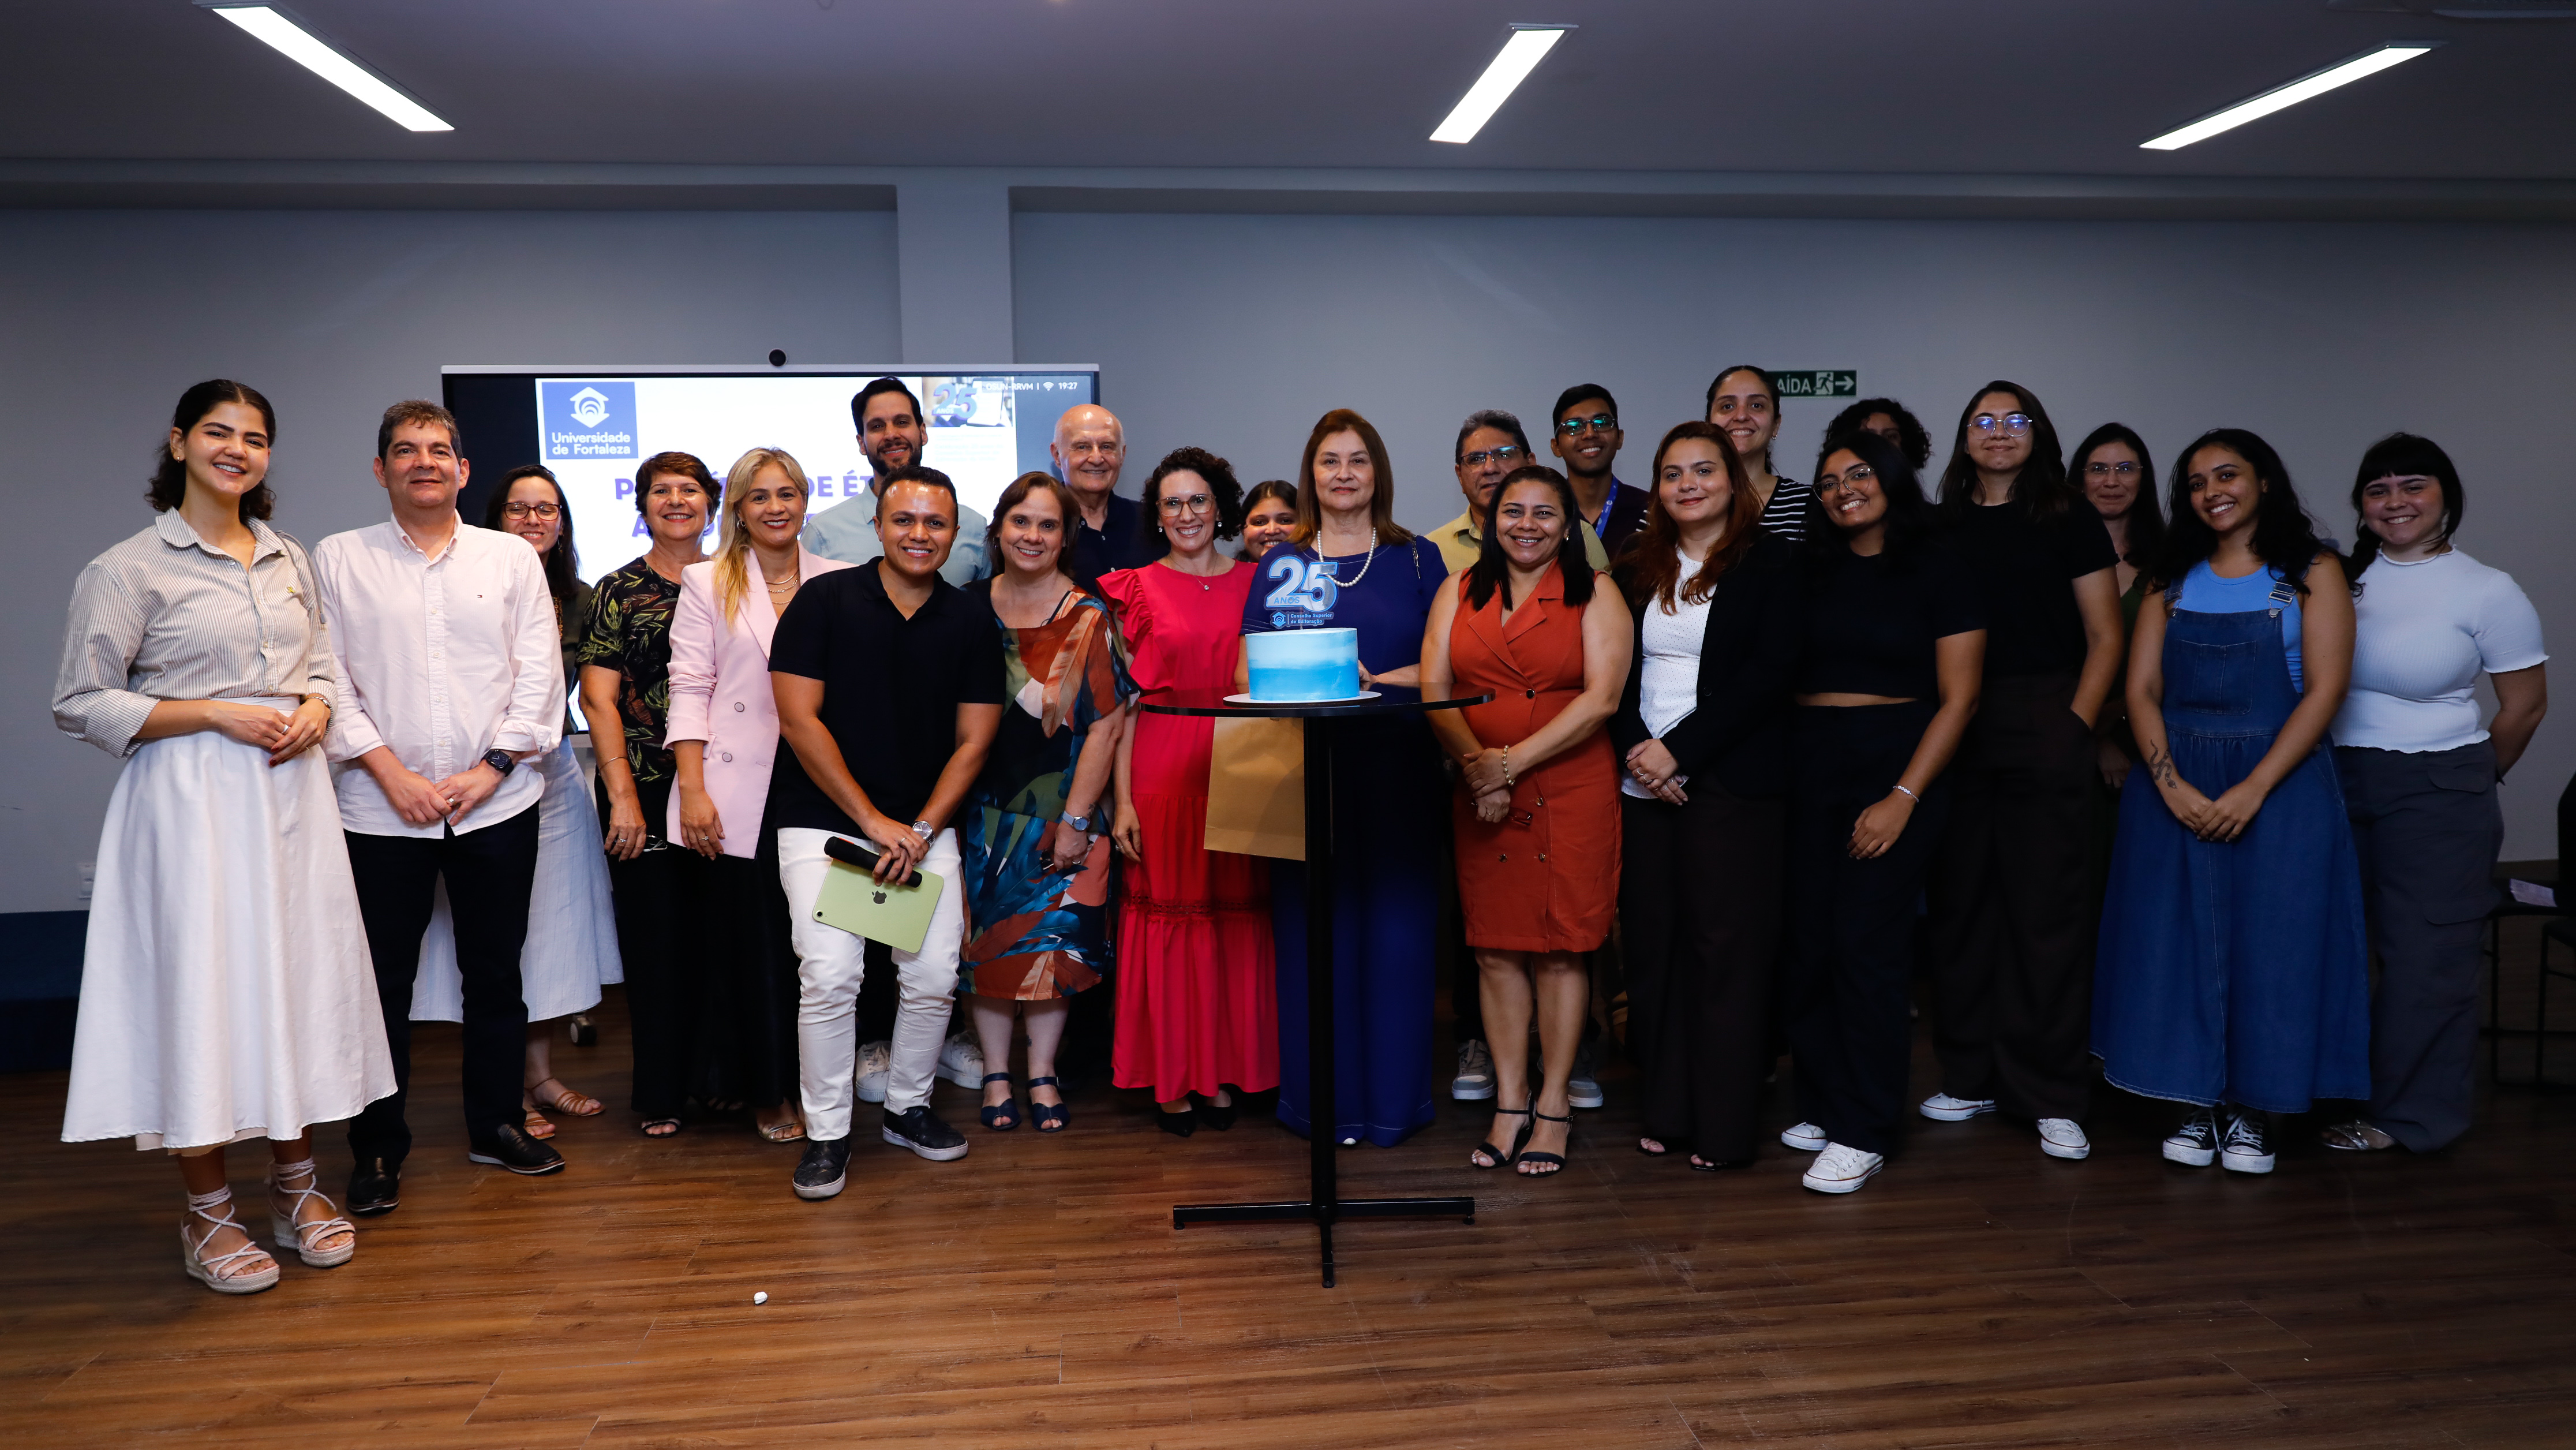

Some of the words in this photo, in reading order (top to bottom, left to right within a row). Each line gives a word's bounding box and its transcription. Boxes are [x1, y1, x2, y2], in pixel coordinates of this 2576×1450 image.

[1058, 382, 1078, 390] 19:27
[1777, 375, 1812, 394] AÍDA
[932, 383, 977, 421] 25
[552, 432, 631, 443] Universidade
[552, 443, 569, 455] de
[574, 443, 631, 455] Fortaleza
[1266, 556, 1338, 612] 25
